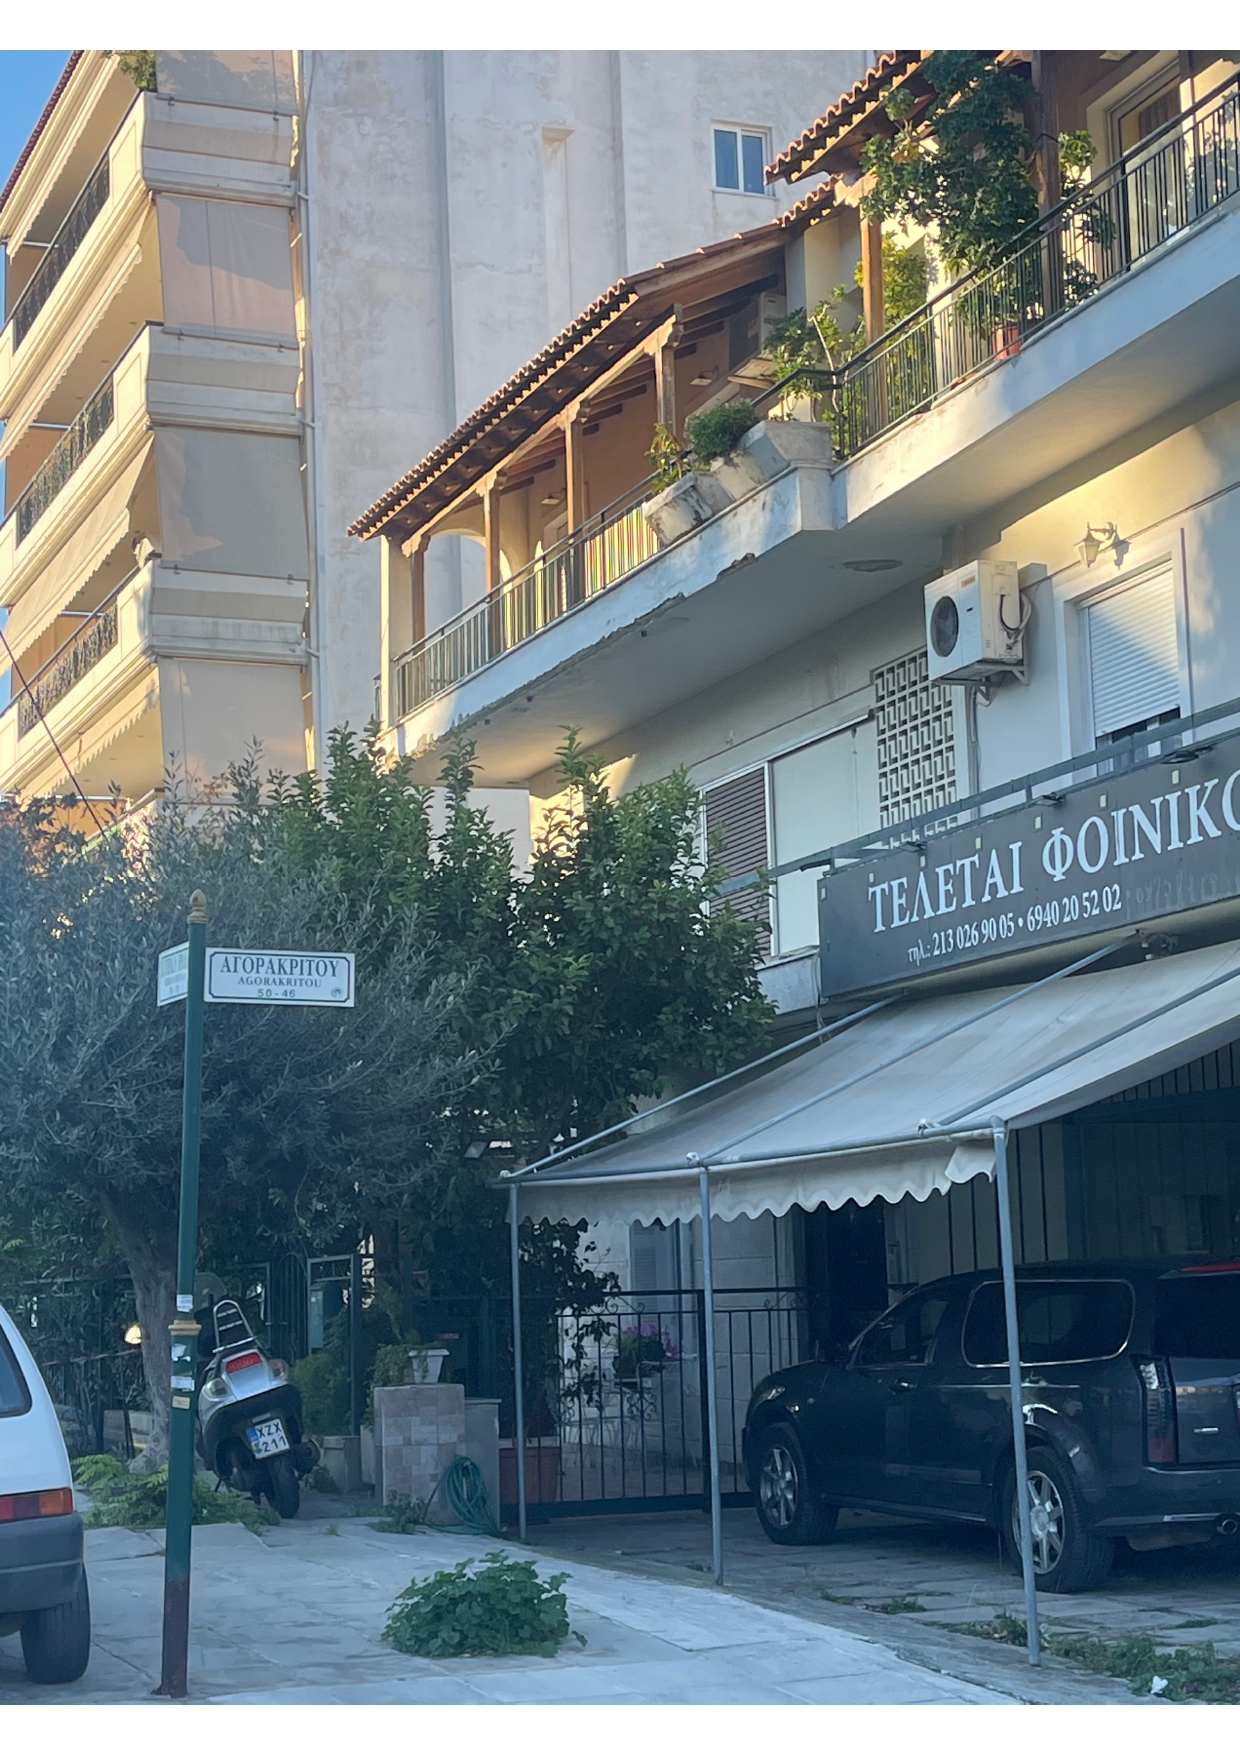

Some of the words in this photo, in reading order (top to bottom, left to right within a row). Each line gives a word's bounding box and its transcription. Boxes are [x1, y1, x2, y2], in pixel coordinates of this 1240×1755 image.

[868, 841, 1025, 933] ΤΕΛΕΤΑΙ
[932, 928, 954, 956] 213
[956, 921, 979, 950] 026
[981, 917, 997, 943] 90
[999, 912, 1015, 939] 05
[1027, 900, 1060, 932] 6940
[1062, 894, 1079, 923] 20
[1083, 889, 1100, 918] 52
[1102, 883, 1122, 913] 02
[220, 955, 340, 978] ΑΓΟΡΑΚΡΙΤΟΥ
[237, 976, 322, 988] AGORAKRITOU
[261, 1435, 288, 1454] 211
